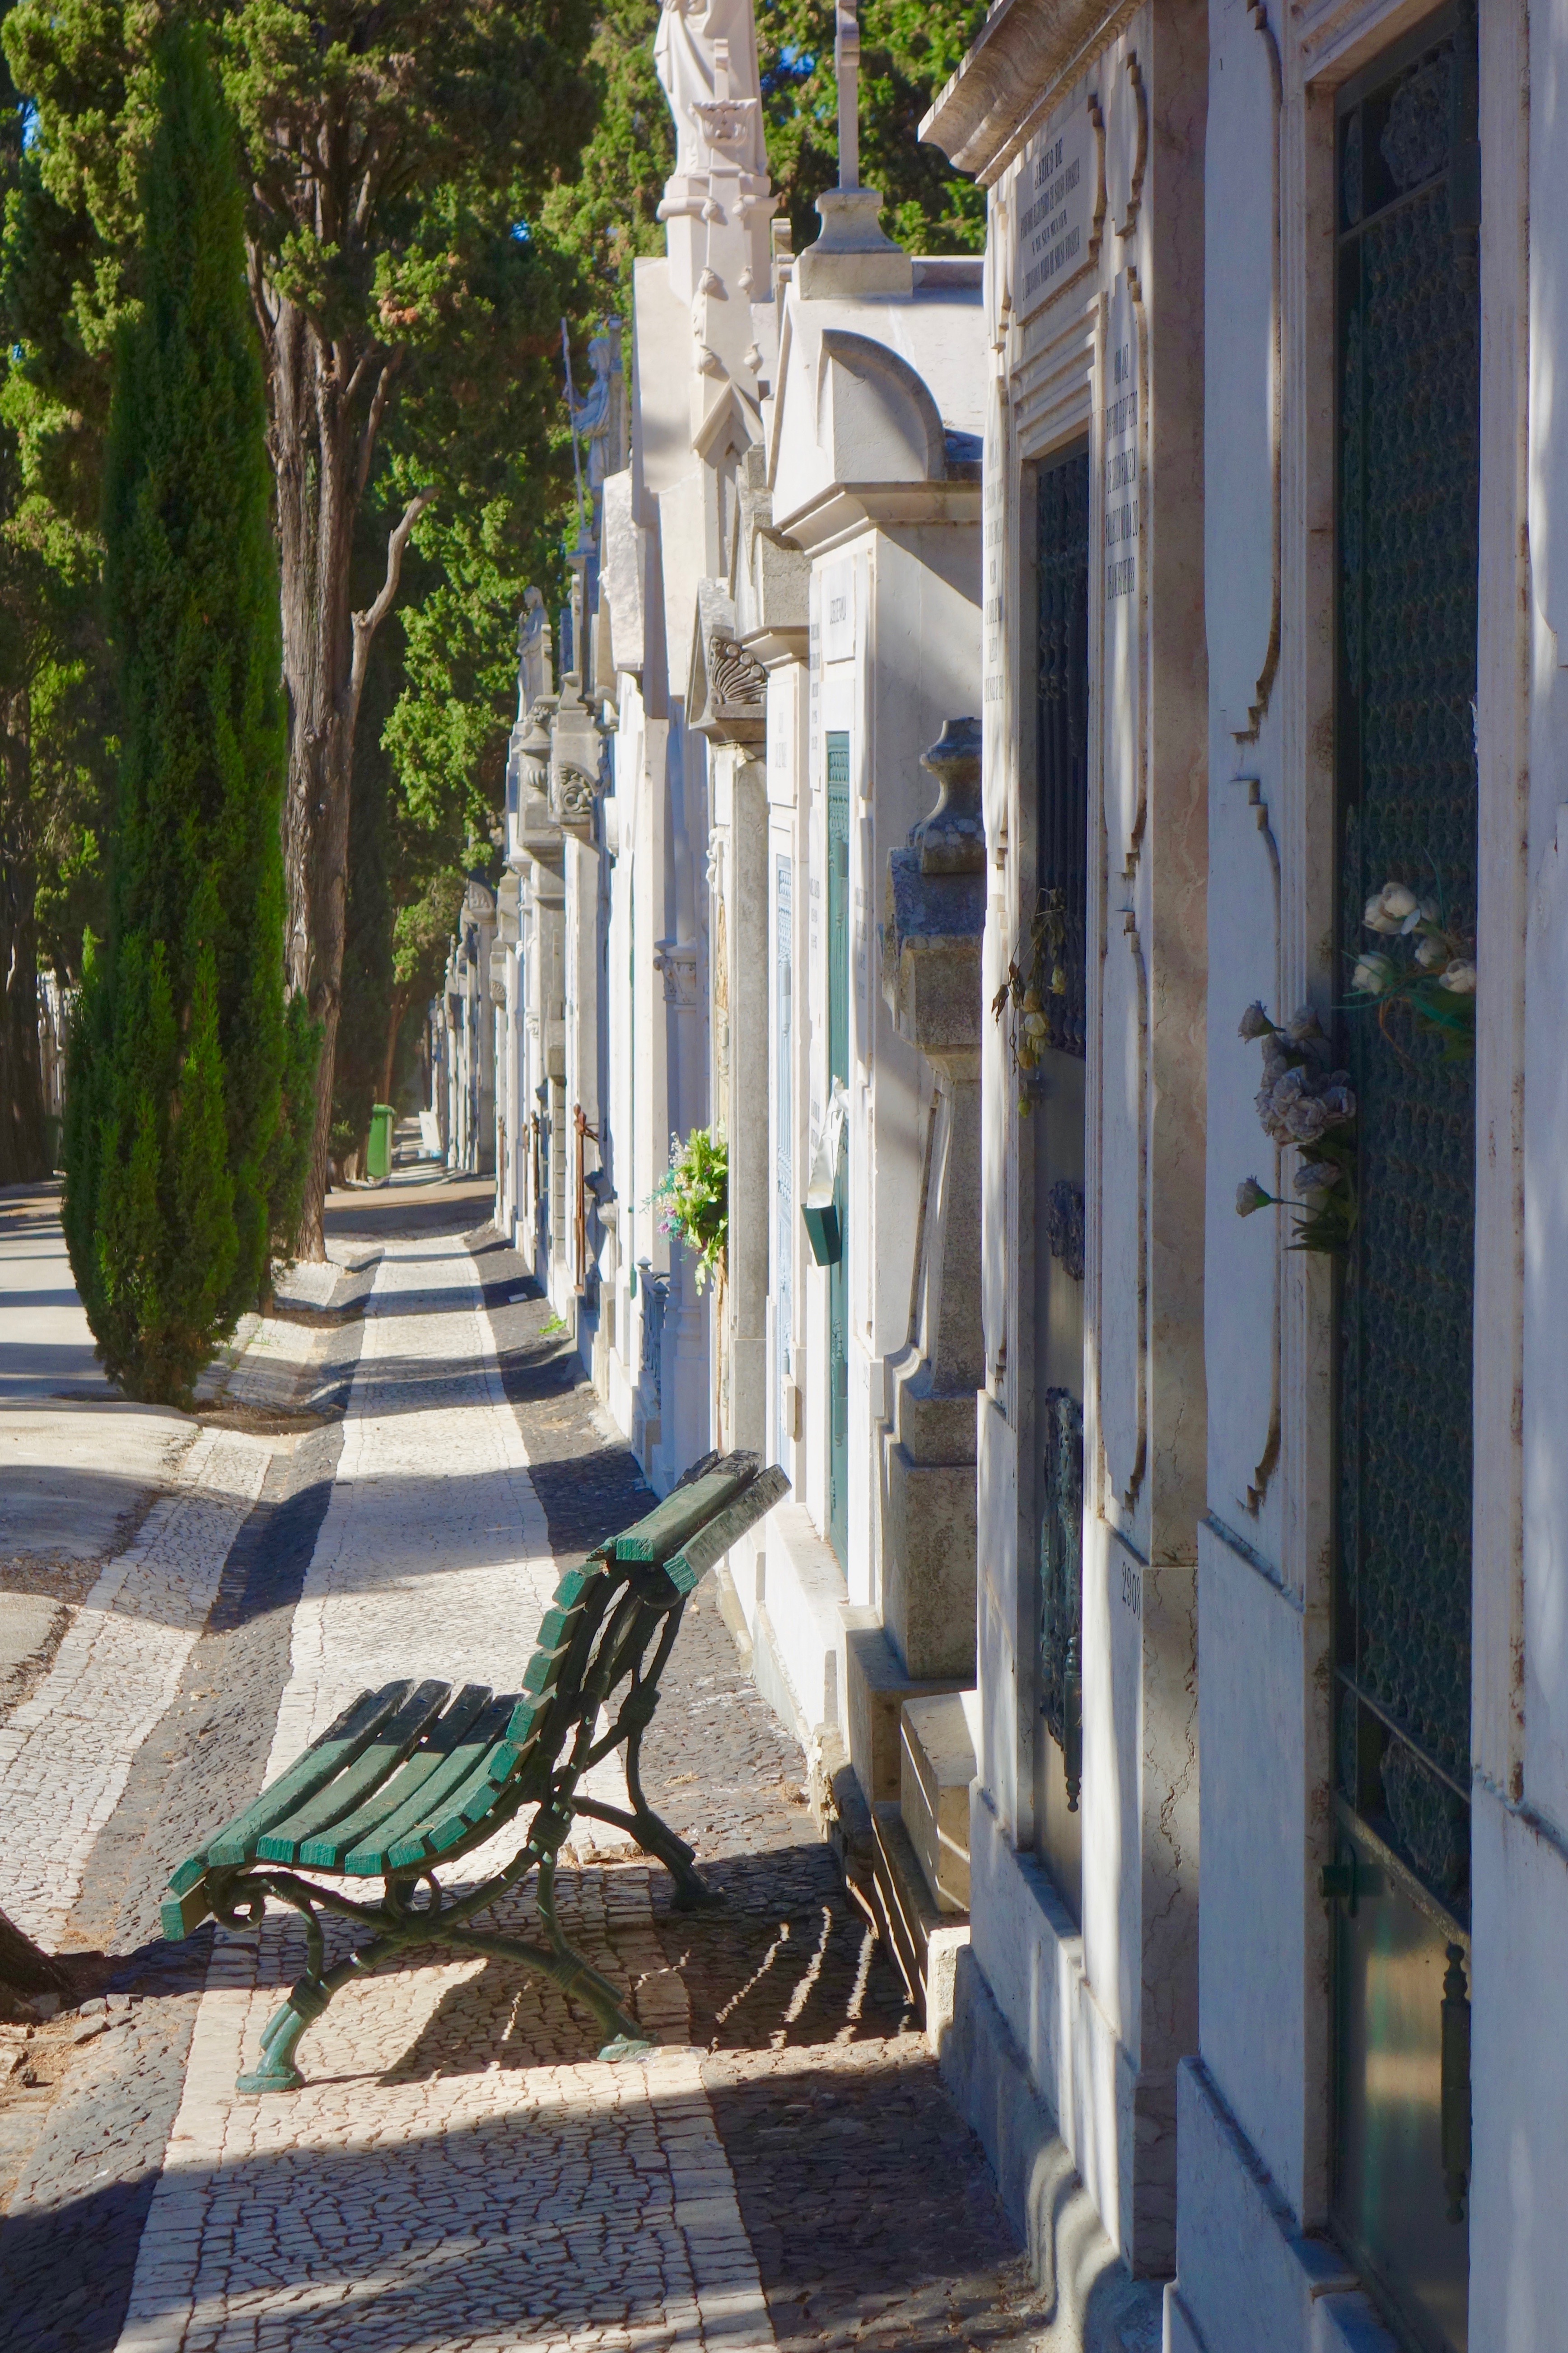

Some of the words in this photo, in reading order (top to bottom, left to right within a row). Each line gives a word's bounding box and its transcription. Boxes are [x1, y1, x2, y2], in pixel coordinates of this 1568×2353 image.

[1055, 136, 1063, 168] DE
[1036, 235, 1041, 253] DE
[1041, 226, 1050, 247] SUA
[1132, 499, 1138, 537] 20
[1122, 1561, 1141, 1620] 2908
